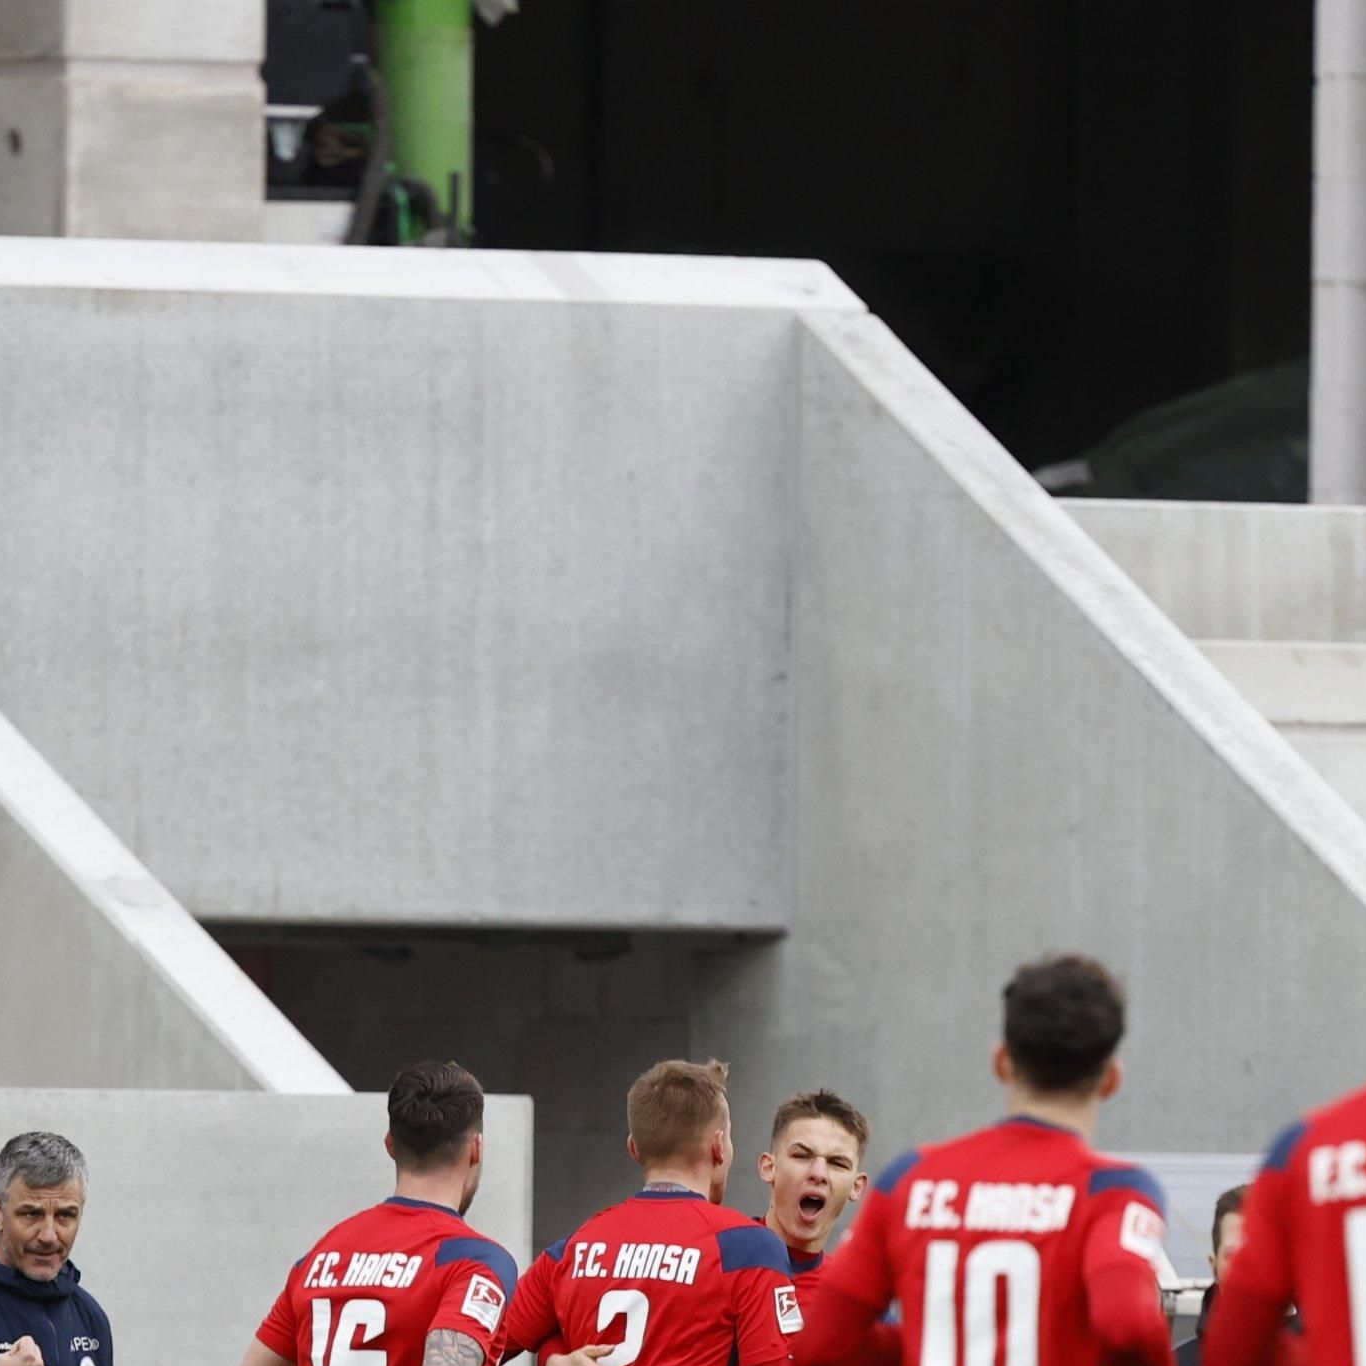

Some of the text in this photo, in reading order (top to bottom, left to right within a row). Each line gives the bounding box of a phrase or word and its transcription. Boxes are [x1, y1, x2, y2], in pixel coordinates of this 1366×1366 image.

[905, 1179, 1076, 1234] F.C. HANSA
[303, 1252, 423, 1289] F.C. HANSA
[571, 1242, 701, 1285] F.C. HANSA
